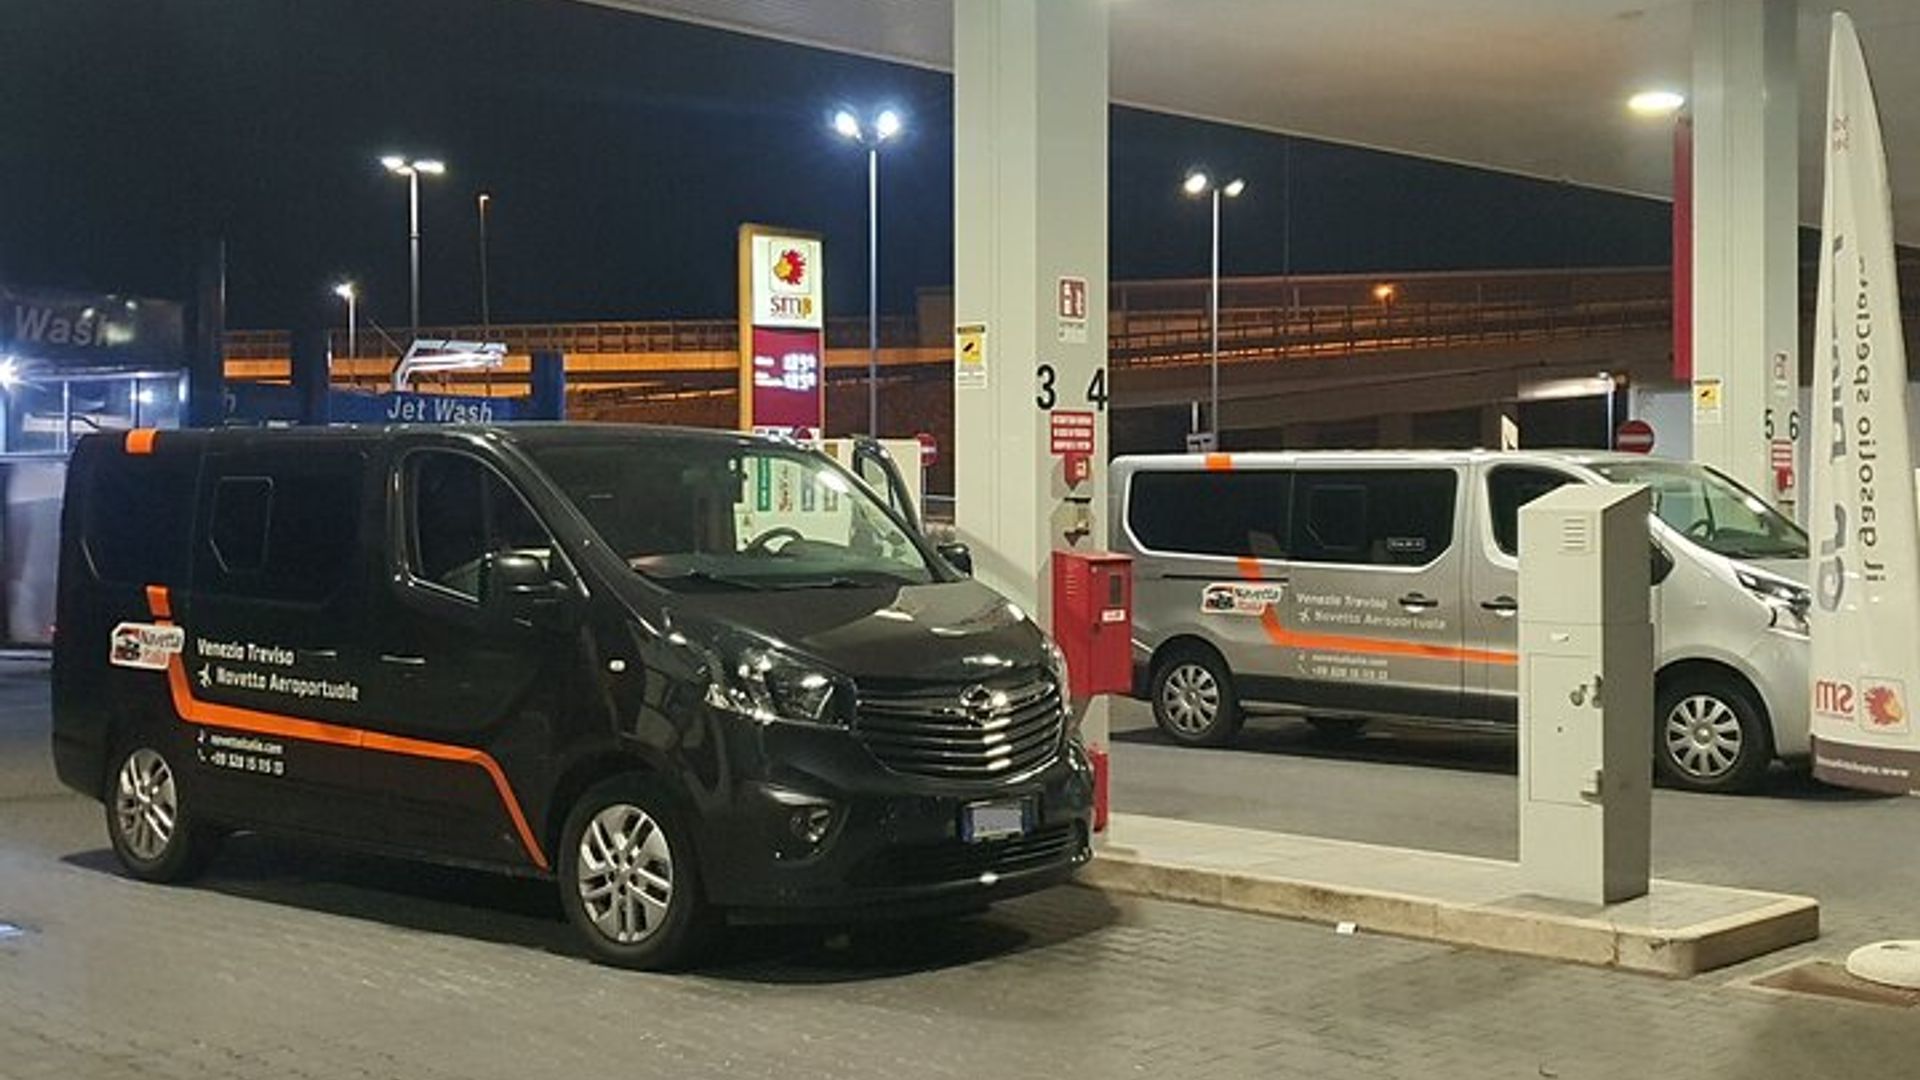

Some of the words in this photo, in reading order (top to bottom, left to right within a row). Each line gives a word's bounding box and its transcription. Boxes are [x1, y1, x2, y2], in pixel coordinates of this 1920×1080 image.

[1036, 365, 1056, 410] 3
[1087, 368, 1108, 411] 4
[387, 396, 424, 420] Jet
[434, 398, 493, 424] Wash
[1765, 409, 1775, 440] 5
[1789, 411, 1799, 440] 6
[1297, 593, 1342, 607] Venezia
[1314, 610, 1361, 625] Navetta
[197, 638, 245, 660] Venezia
[248, 643, 295, 666] Treviso
[216, 666, 267, 689] Navetta
[269, 673, 359, 701] Aeroportuale
